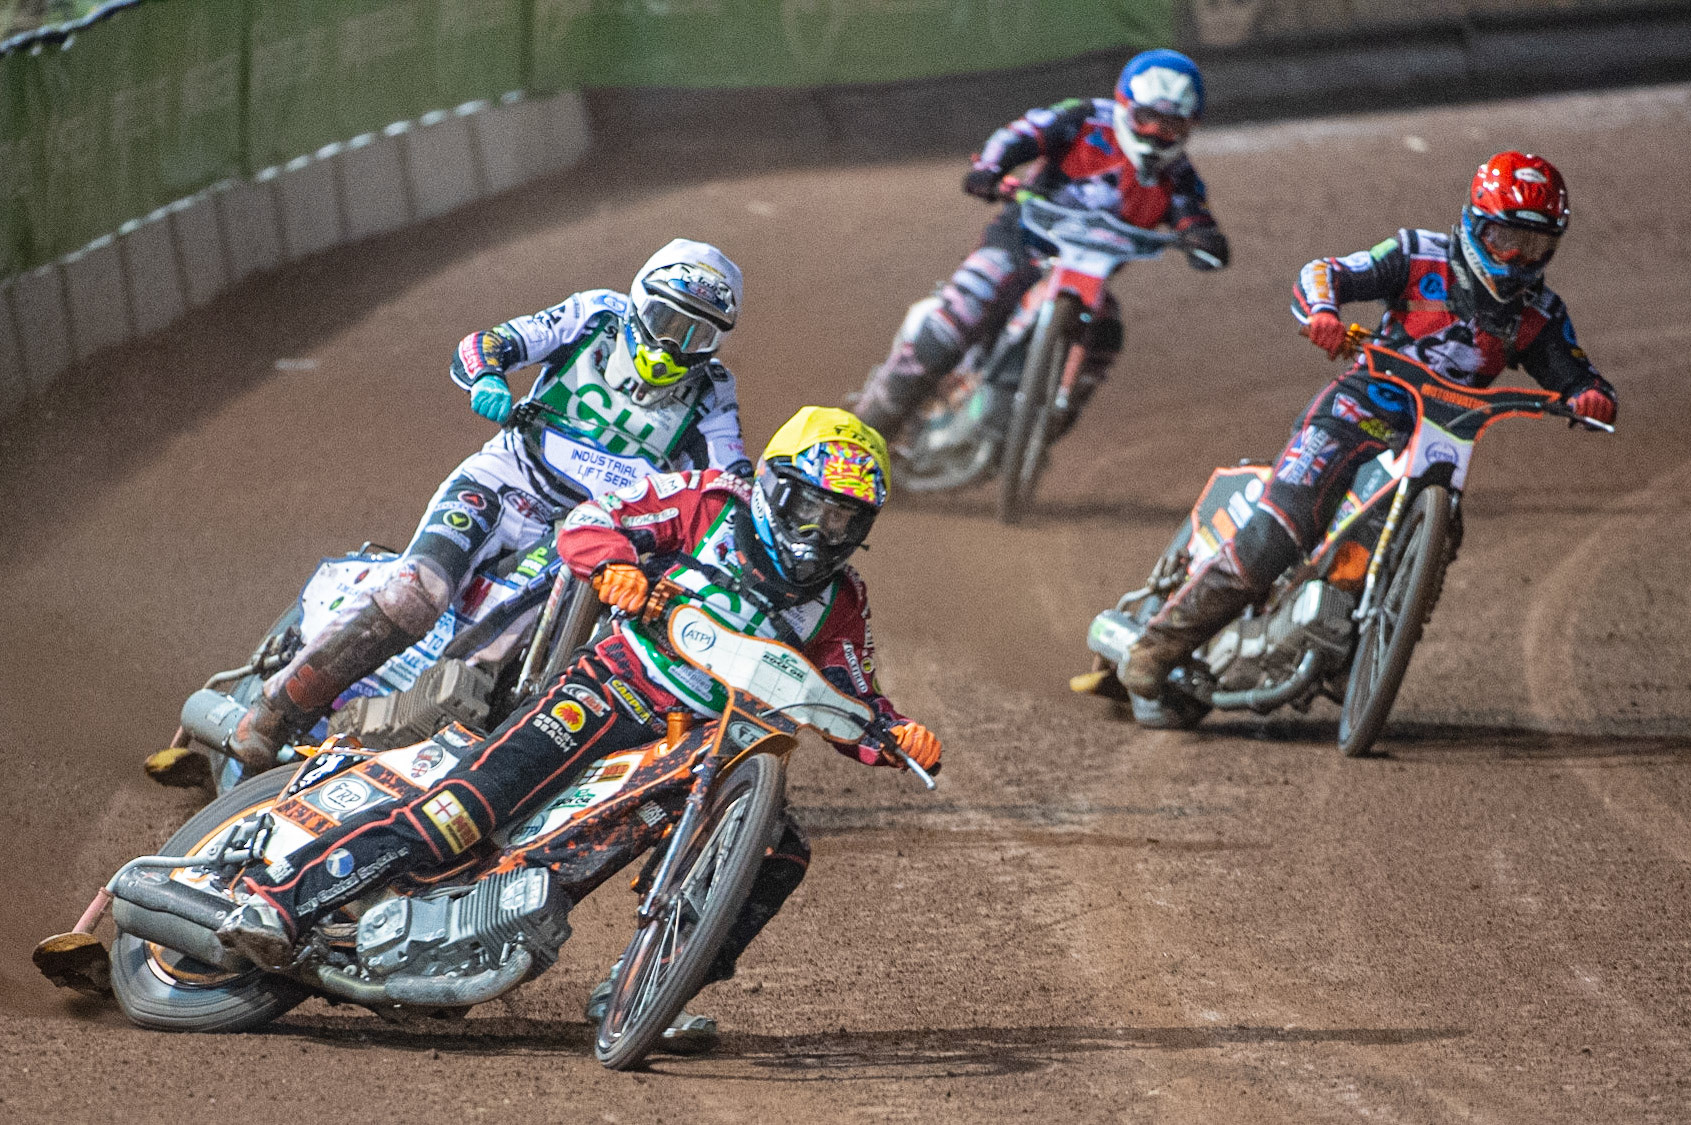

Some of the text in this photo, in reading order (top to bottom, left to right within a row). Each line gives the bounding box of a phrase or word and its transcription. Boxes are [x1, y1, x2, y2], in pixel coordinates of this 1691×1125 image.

[571, 448, 637, 479] INDUSTRIAL
[577, 464, 602, 480] LIFT
[685, 629, 712, 645] ATPI
[762, 653, 789, 670] ROCK
[533, 718, 570, 753] BEACH
